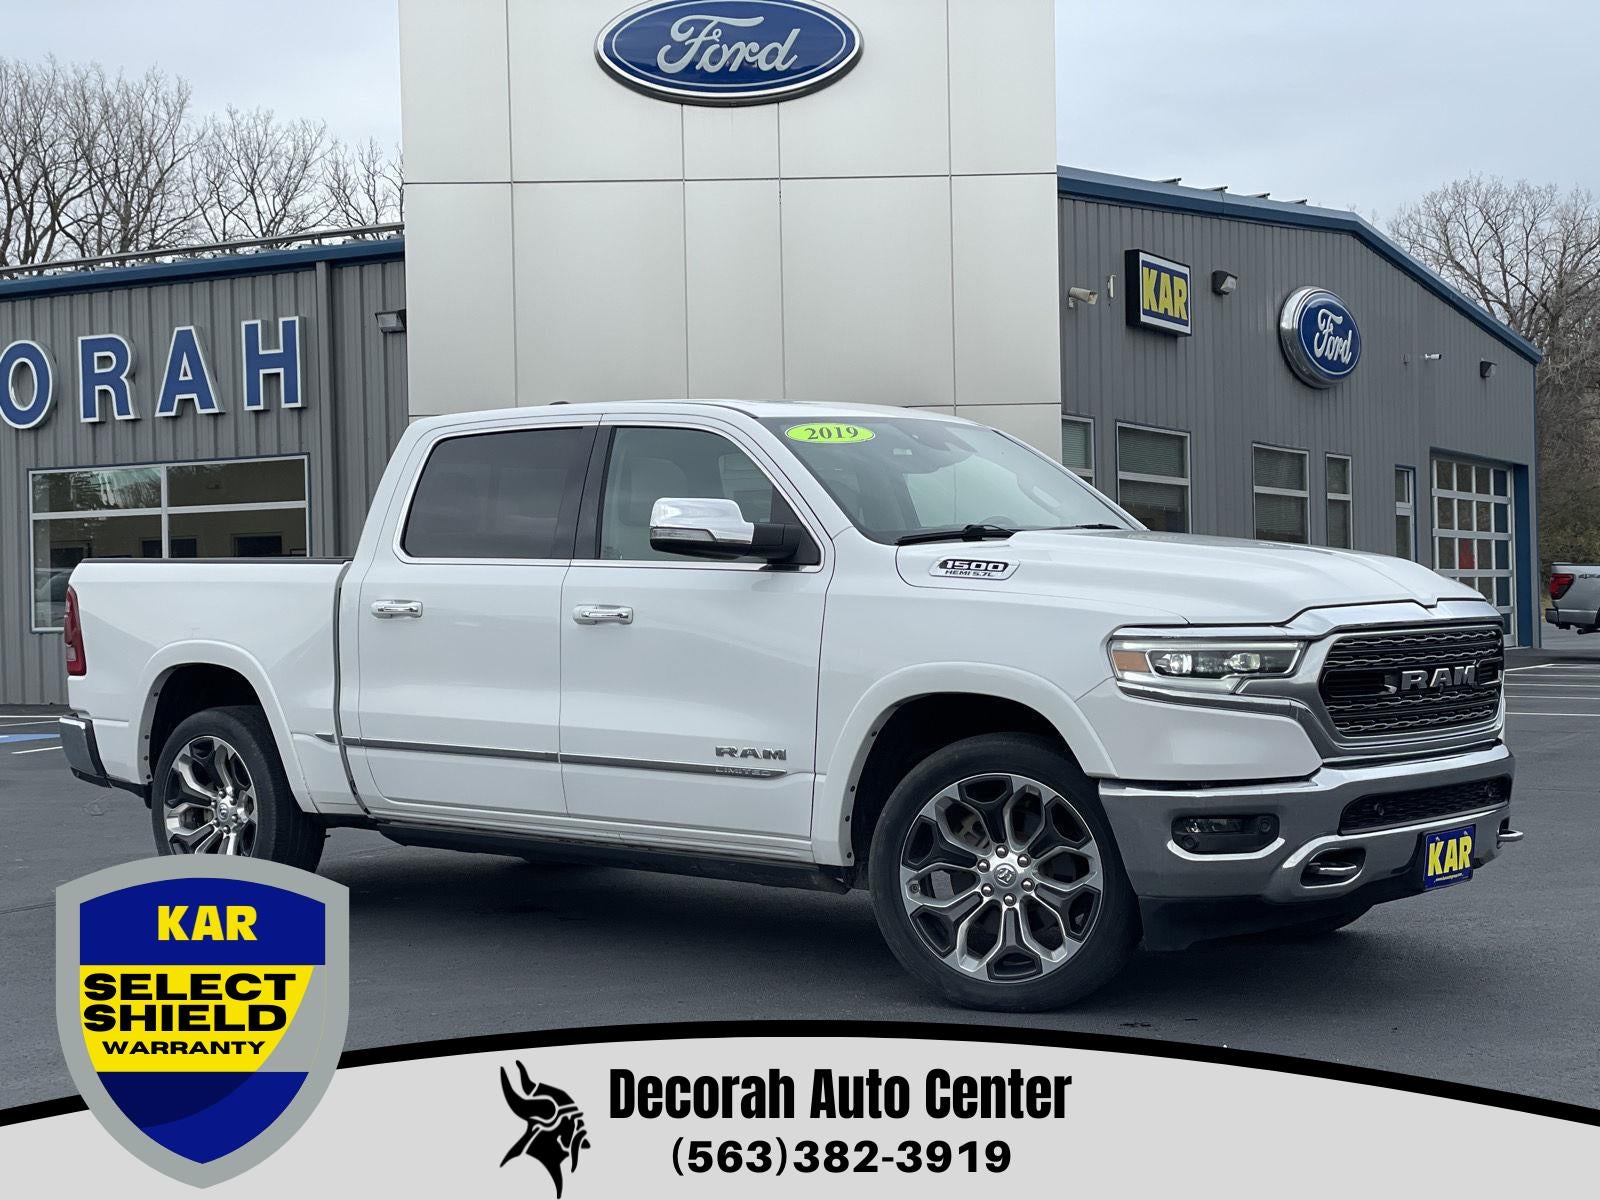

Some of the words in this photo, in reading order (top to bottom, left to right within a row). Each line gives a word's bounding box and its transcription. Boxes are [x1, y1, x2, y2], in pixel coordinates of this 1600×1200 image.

[657, 15, 801, 74] Ford
[1141, 265, 1188, 321] KAR
[1313, 308, 1353, 364] Ford
[0, 315, 306, 429] ORAH
[804, 426, 859, 440] 2019
[945, 560, 1005, 571] 1500
[1401, 665, 1476, 690] RAM
[715, 745, 787, 760] RAM
[715, 767, 771, 777] LIMITED
[1427, 835, 1473, 877] KAR
